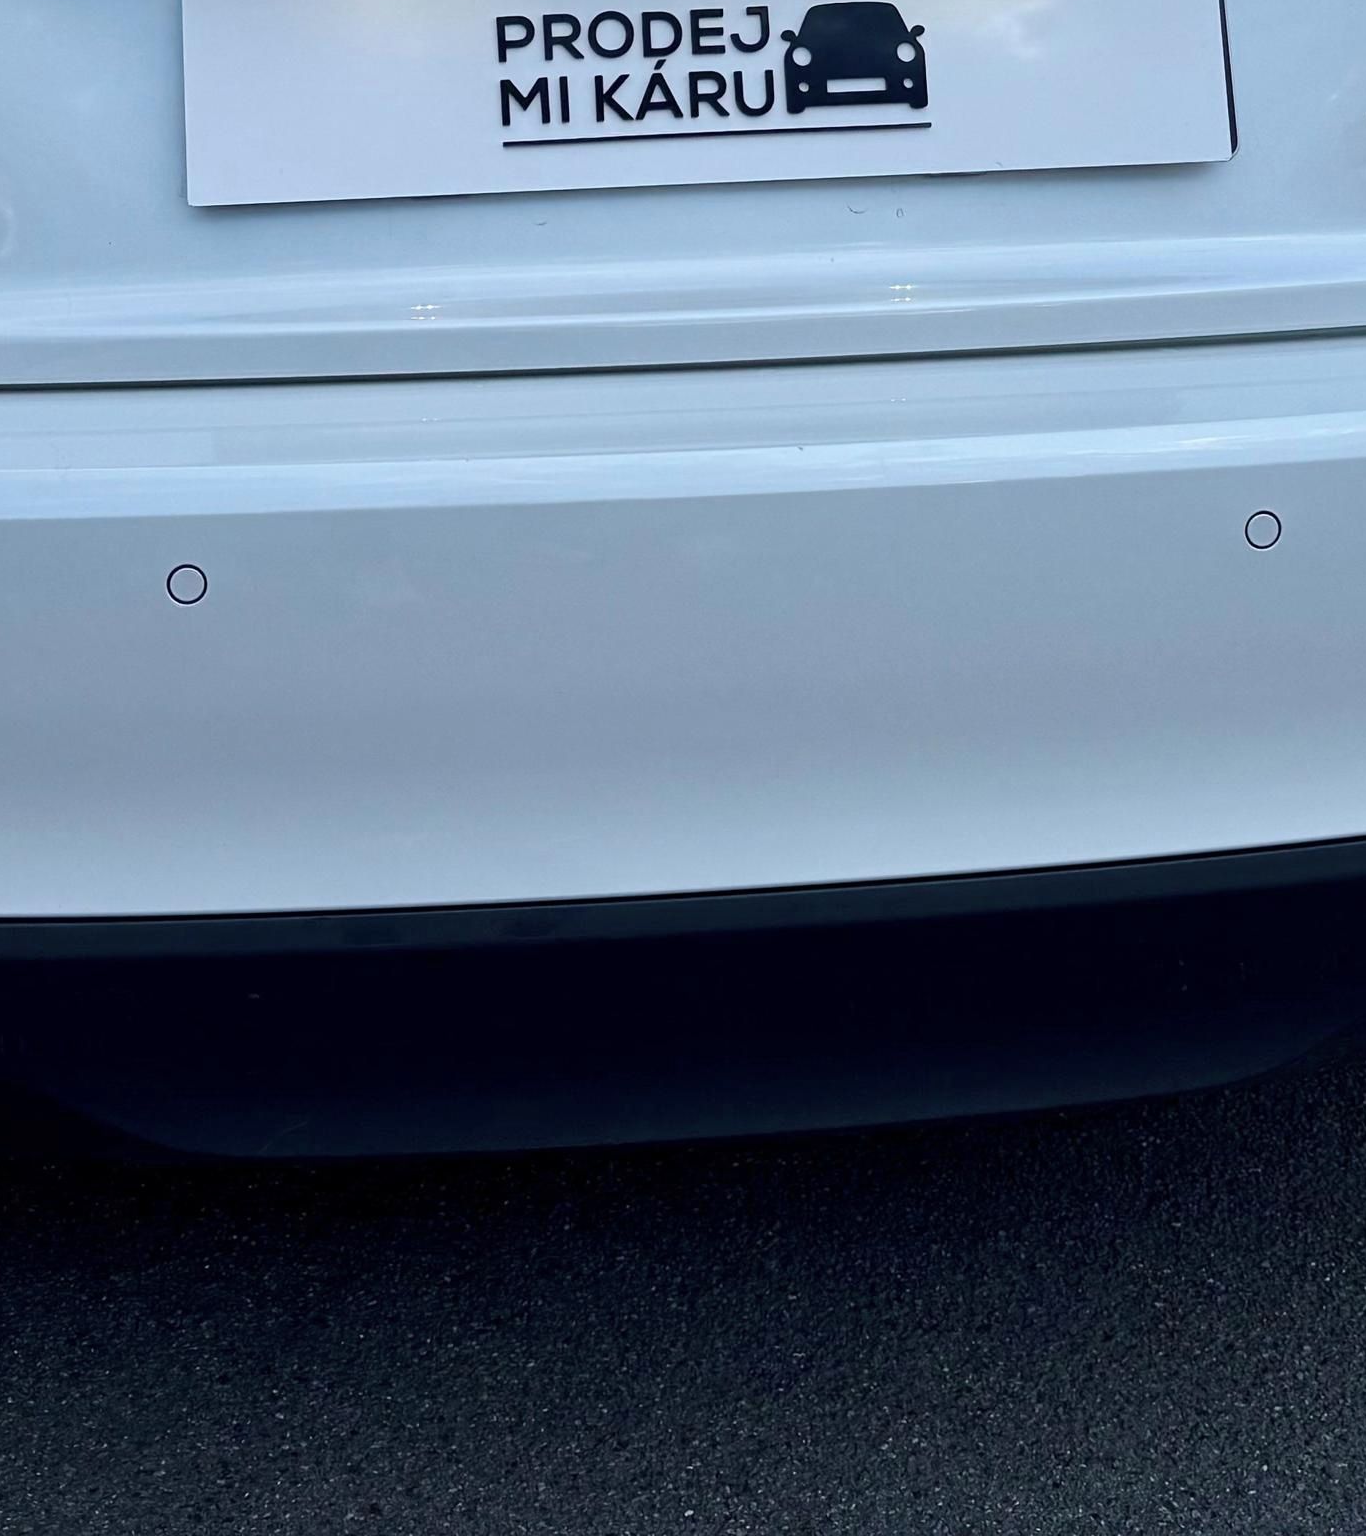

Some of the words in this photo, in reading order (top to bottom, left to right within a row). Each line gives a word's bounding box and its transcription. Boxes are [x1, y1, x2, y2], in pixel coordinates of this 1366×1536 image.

[495, 5, 771, 64] PRODEJ
[499, 75, 571, 127] MI
[594, 58, 775, 123] KÁRU
